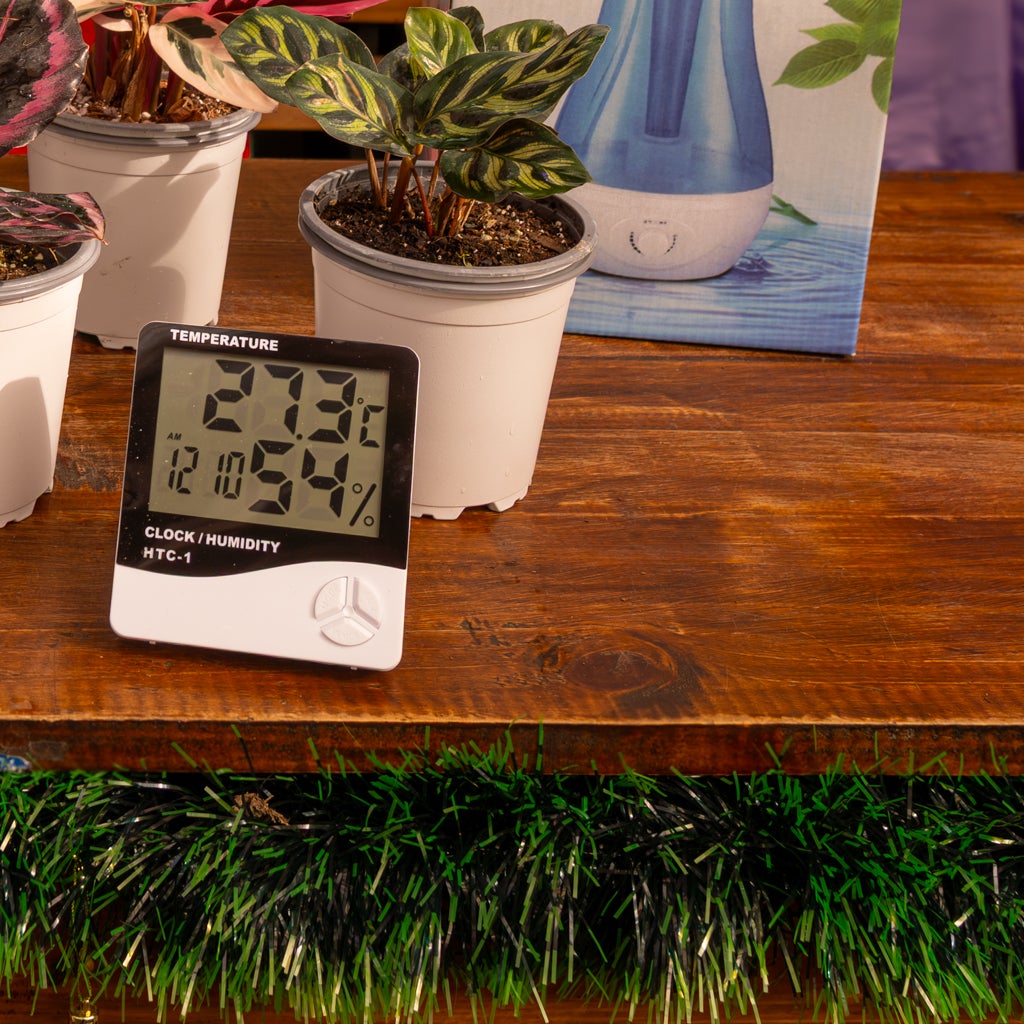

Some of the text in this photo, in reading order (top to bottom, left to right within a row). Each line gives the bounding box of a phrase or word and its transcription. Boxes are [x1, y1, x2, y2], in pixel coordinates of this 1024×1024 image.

[170, 328, 279, 352] TEMPERATURE
[166, 432, 182, 441] AM
[143, 546, 192, 564] HTC-1
